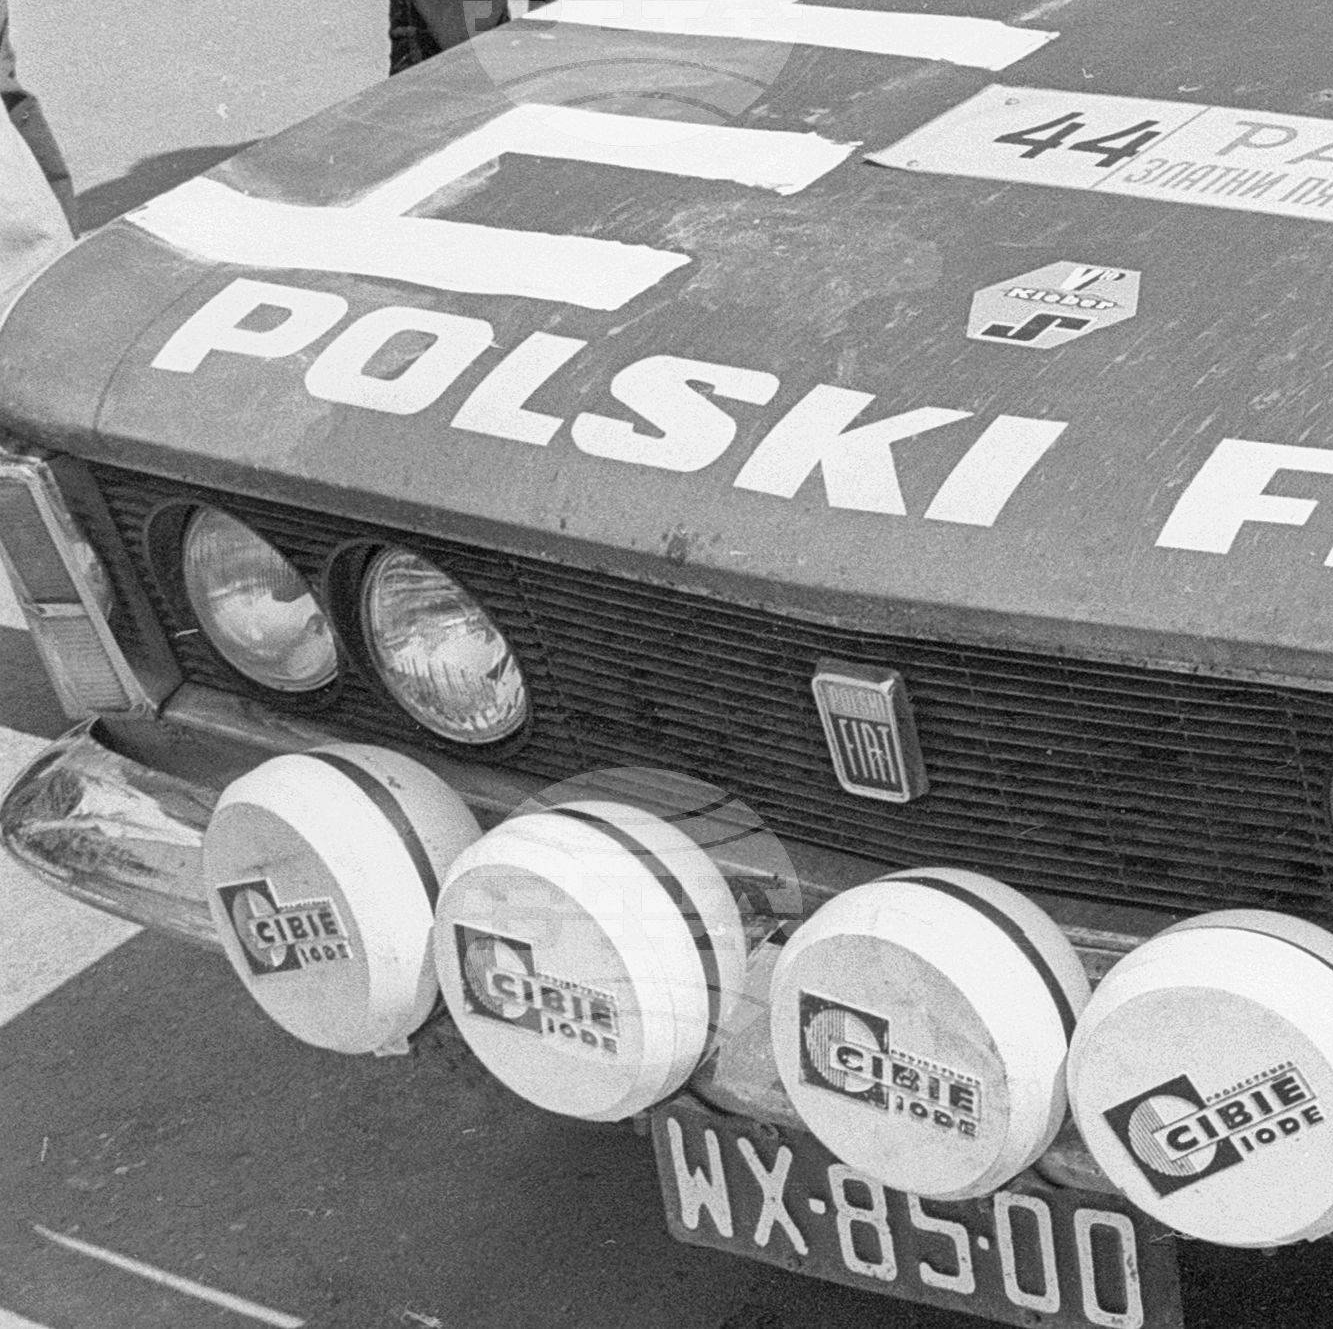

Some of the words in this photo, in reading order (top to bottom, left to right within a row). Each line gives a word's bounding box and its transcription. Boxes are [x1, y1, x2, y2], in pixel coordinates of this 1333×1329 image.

[992, 112, 1162, 168] 44
[1123, 158, 1290, 199] ЗЛАТНИ
[150, 277, 1069, 527] POLSKI
[838, 718, 897, 784] FIAT
[1240, 1104, 1325, 1153] IODE
